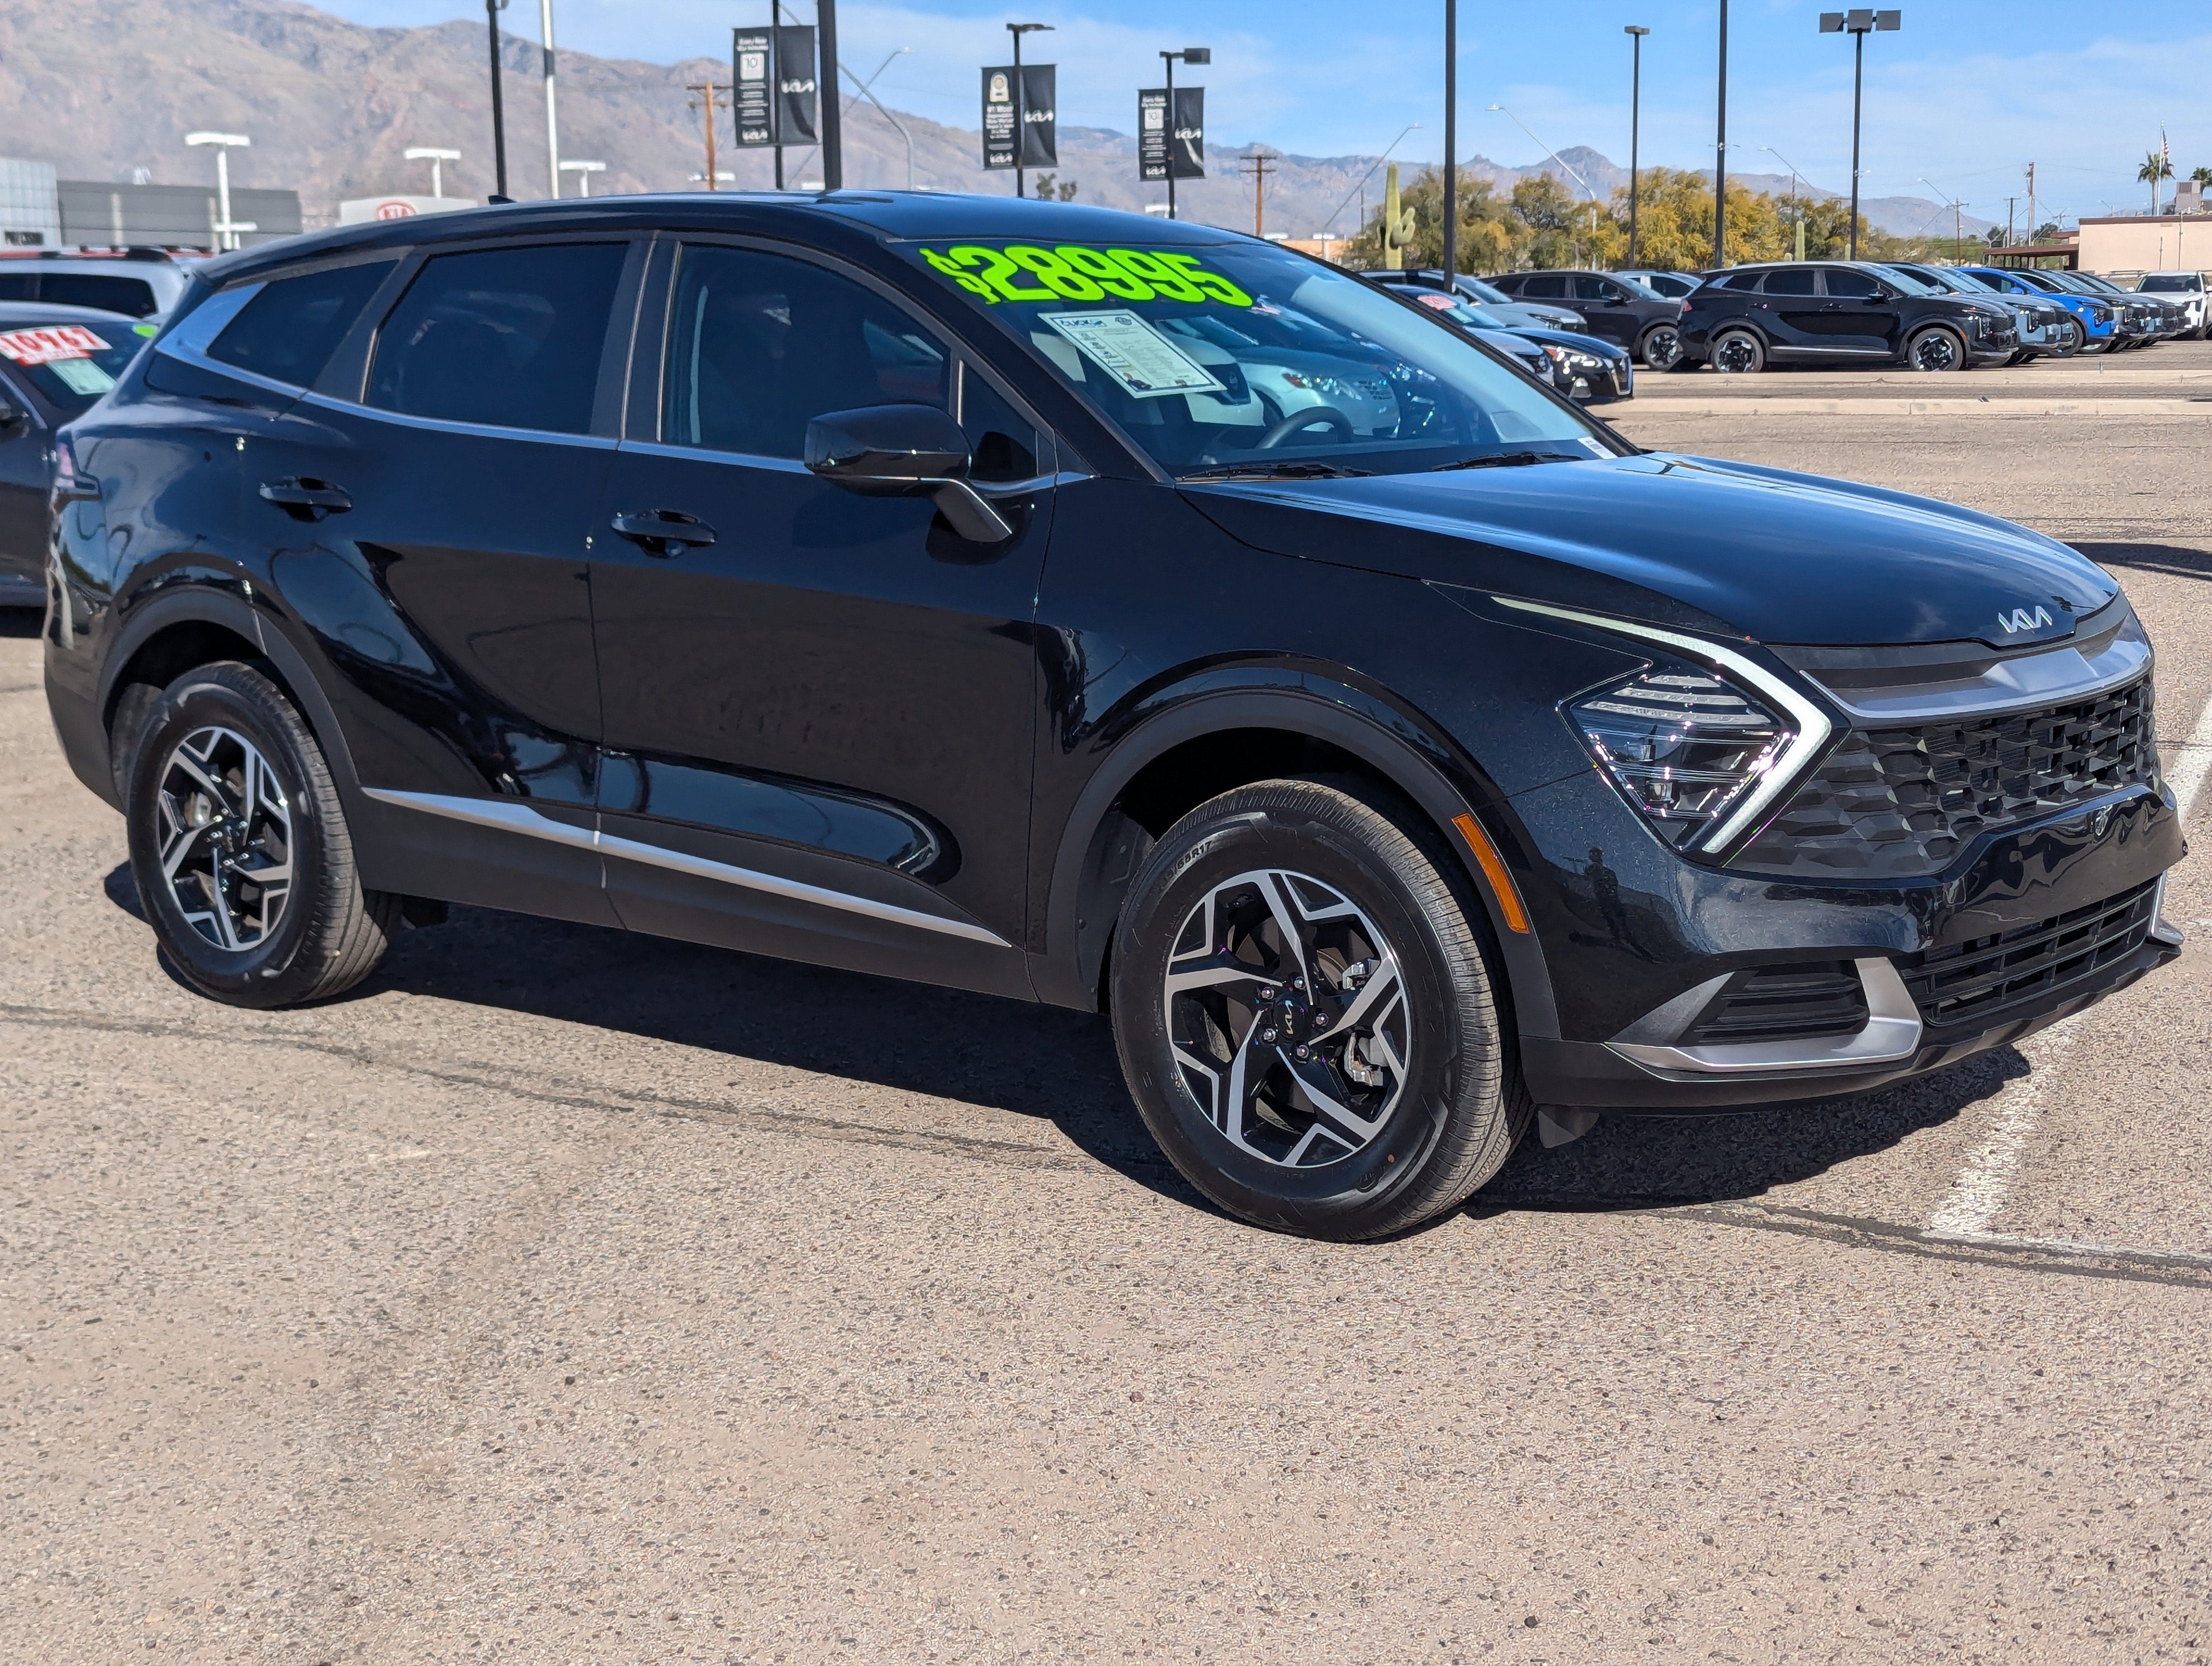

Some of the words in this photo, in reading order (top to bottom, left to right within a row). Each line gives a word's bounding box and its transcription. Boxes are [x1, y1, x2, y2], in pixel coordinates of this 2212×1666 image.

[781, 79, 815, 93] KIA
[919, 246, 1253, 306] $28995
[1998, 605, 2053, 634] KIA
